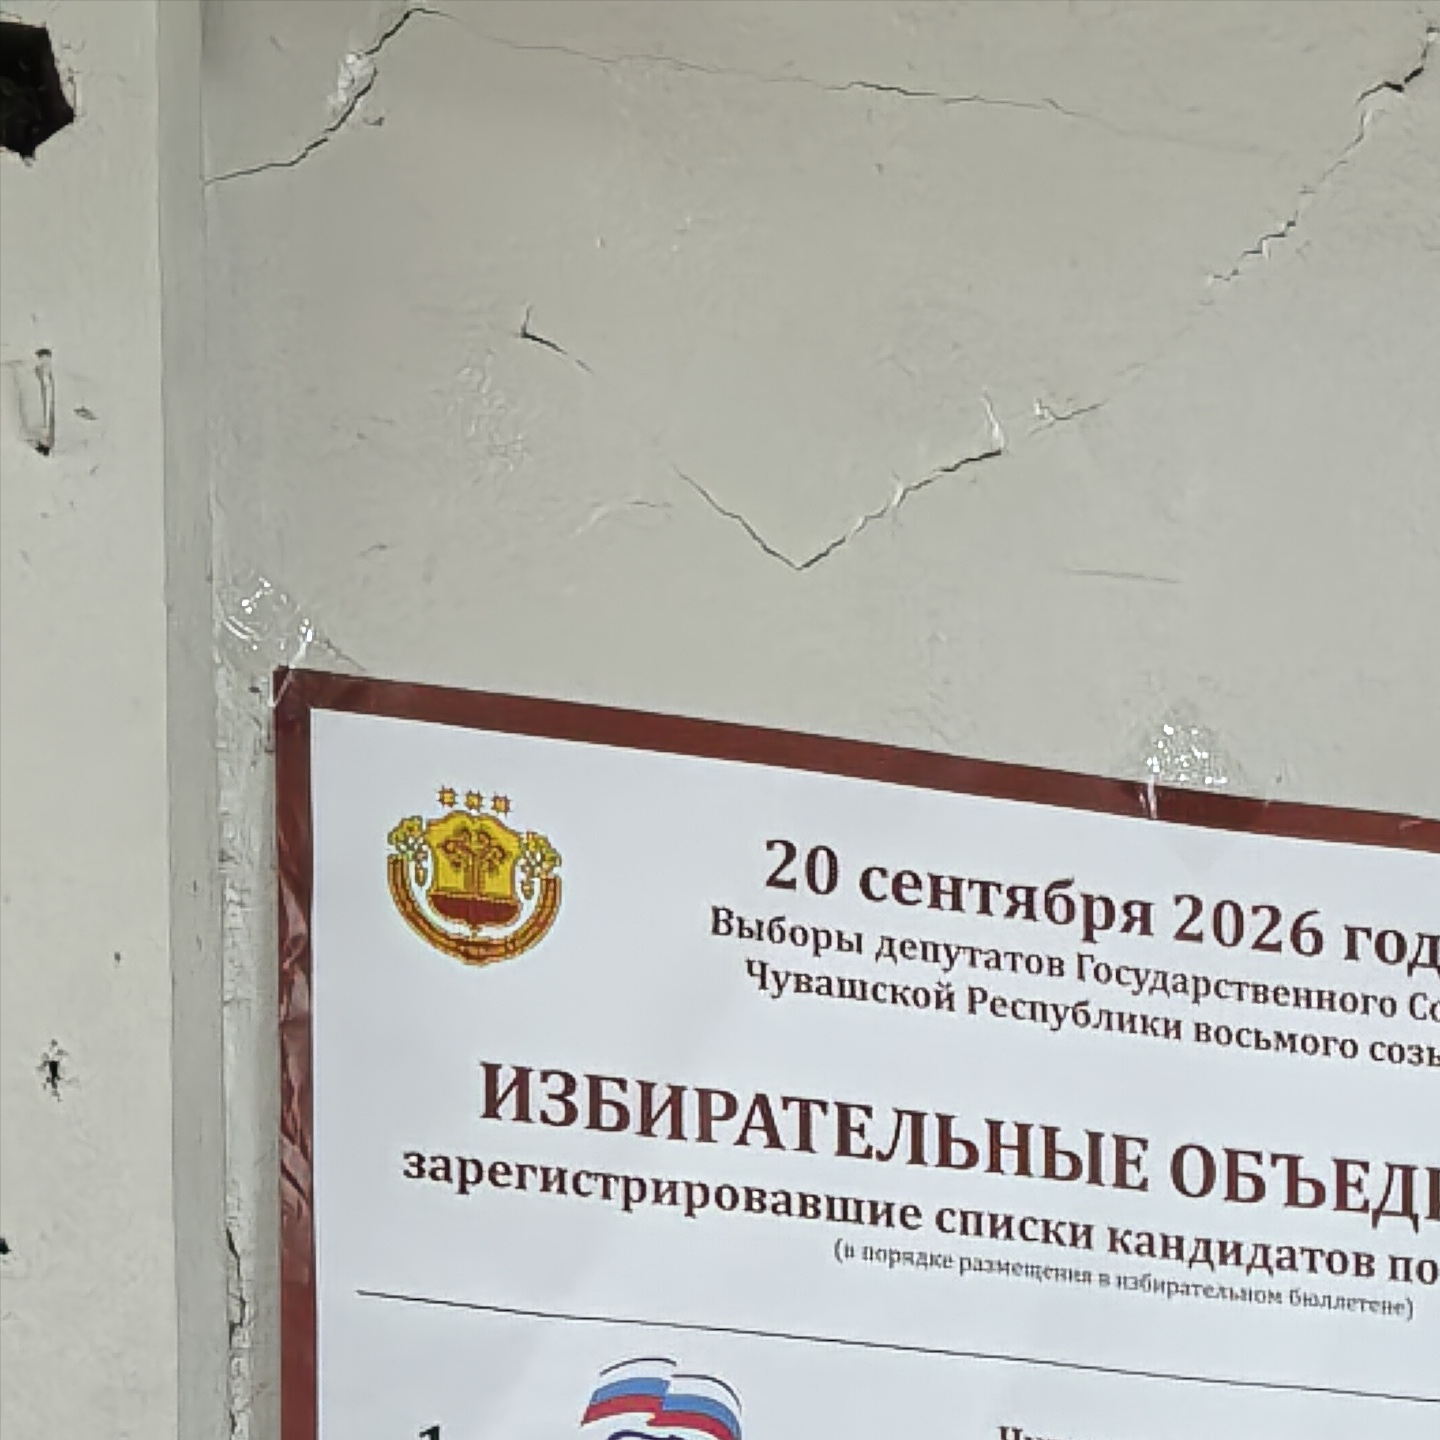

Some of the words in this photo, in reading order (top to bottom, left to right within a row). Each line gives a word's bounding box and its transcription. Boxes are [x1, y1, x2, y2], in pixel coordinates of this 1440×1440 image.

[765, 839, 840, 896] 20
[859, 865, 1156, 945] сентября
[1172, 893, 1325, 958] 2026
[711, 904, 864, 959] Выборы
[874, 935, 1066, 978] депутатов
[1076, 951, 1397, 1018] Государственного
[744, 957, 957, 1012] Чувашской
[967, 984, 1183, 1042] Республики
[1192, 1020, 1359, 1060] восьмого
[479, 1060, 1149, 1192] ИЗБИРАТЕЛЬНЫЕ
[400, 1150, 923, 1231] зарегистрировавшие
[935, 1207, 1096, 1251] списки
[1107, 1225, 1376, 1279] кандидатов
[1387, 1254, 1440, 1286] по
